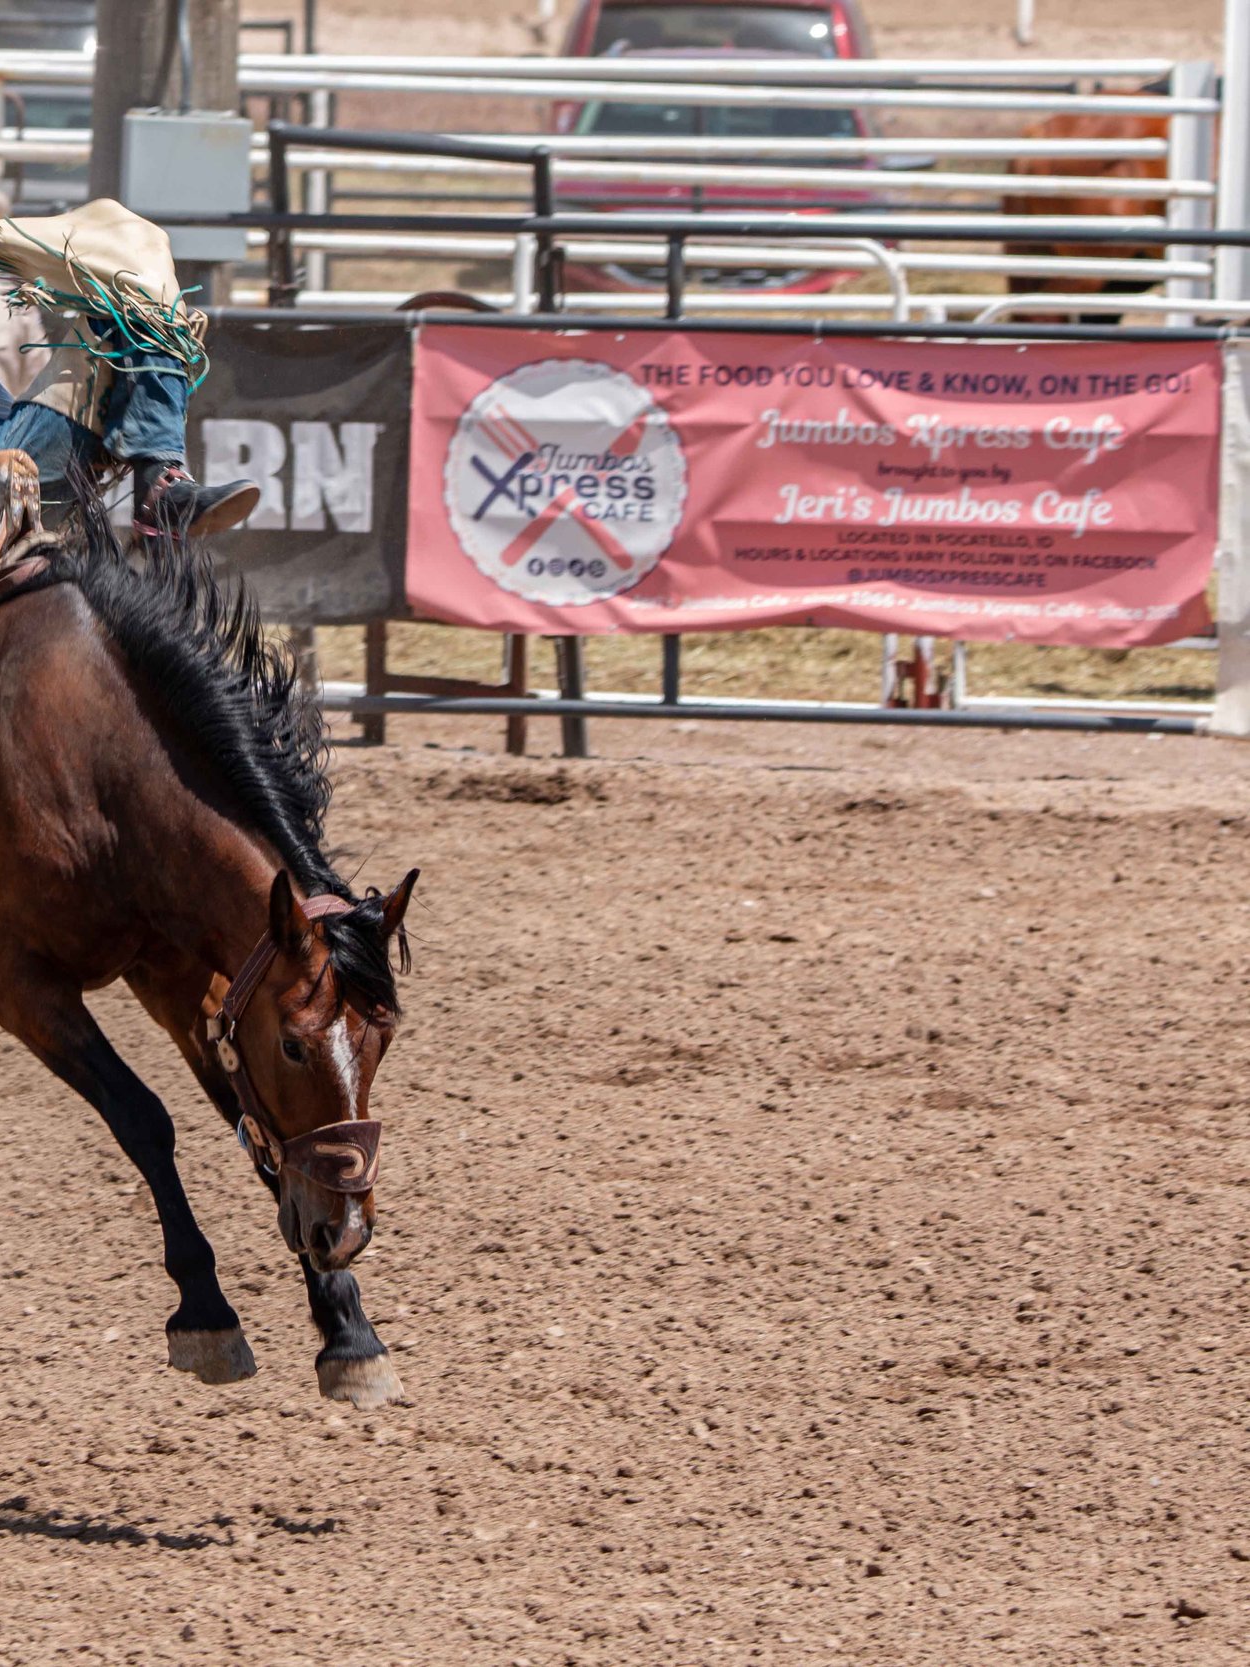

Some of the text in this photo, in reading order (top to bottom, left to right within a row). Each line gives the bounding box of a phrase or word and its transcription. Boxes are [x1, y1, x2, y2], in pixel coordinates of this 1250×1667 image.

[640, 364, 1191, 399] THE FOOD YOU LOVE & KNOW, ON THE GO!
[756, 407, 1125, 465] Jumbos Xpress Cafe
[533, 442, 655, 475] Jumbos
[878, 461, 939, 483] brought
[959, 467, 987, 484] you
[992, 463, 1011, 485] by
[470, 451, 656, 522] Xpress
[582, 503, 654, 522] CAFE
[773, 484, 1114, 538] Jeri's Jumbos Cafe
[837, 532, 911, 545] LOCATED
[915, 533, 931, 545] IN
[734, 548, 1157, 570] HOURS & LOCATIONS VARY FOLLOW US ON FACEBOOK
